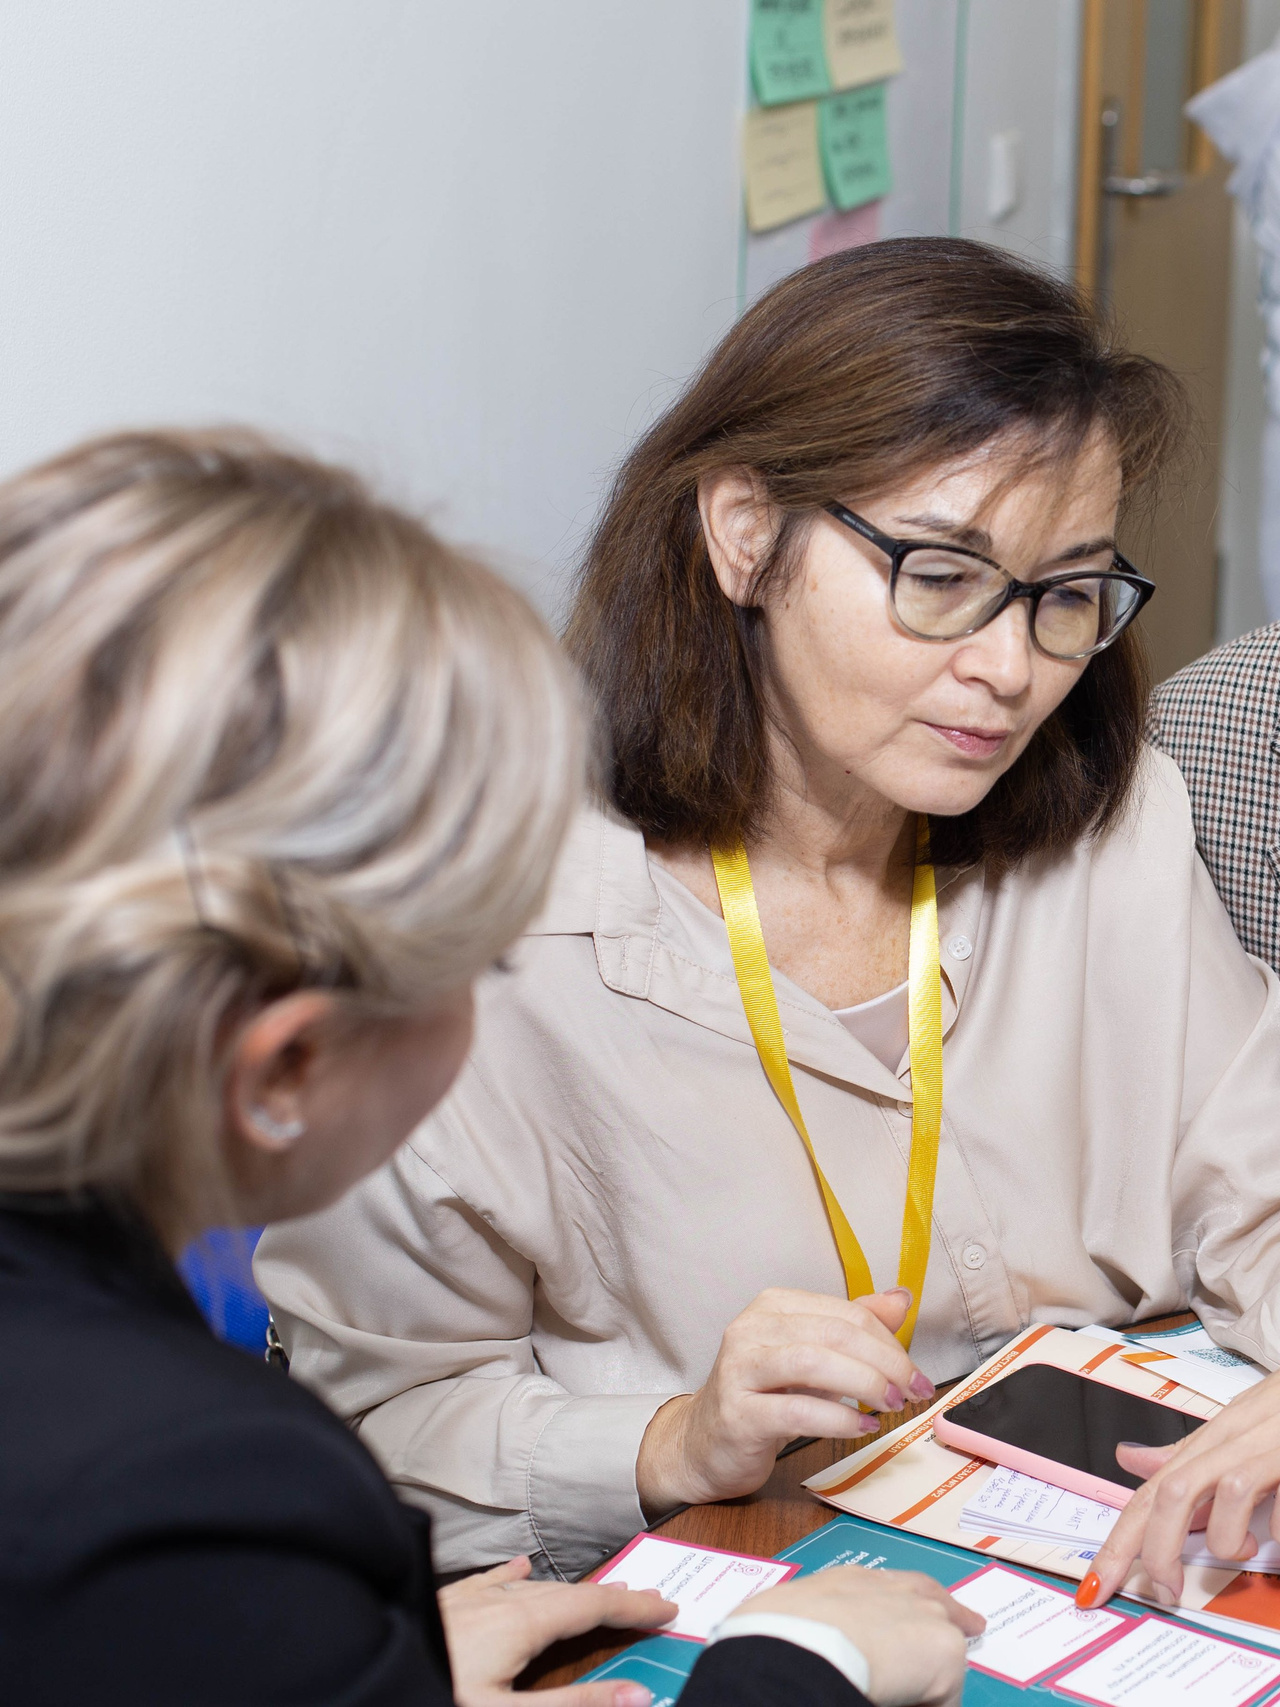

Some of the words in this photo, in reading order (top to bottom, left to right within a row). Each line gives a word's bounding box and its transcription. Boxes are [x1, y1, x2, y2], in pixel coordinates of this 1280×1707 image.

[980, 1351, 1018, 1377] ВЫСТАВКА
[889, 1442, 906, 1453] ЗАЛ
[930, 1486, 945, 1498] №2
[942, 1479, 958, 1490] №1,
[653, 1552, 697, 1588] полностью
[690, 1556, 716, 1573] Штат
[654, 1573, 695, 1601] укомпле
[988, 1588, 1035, 1618] увеличена
